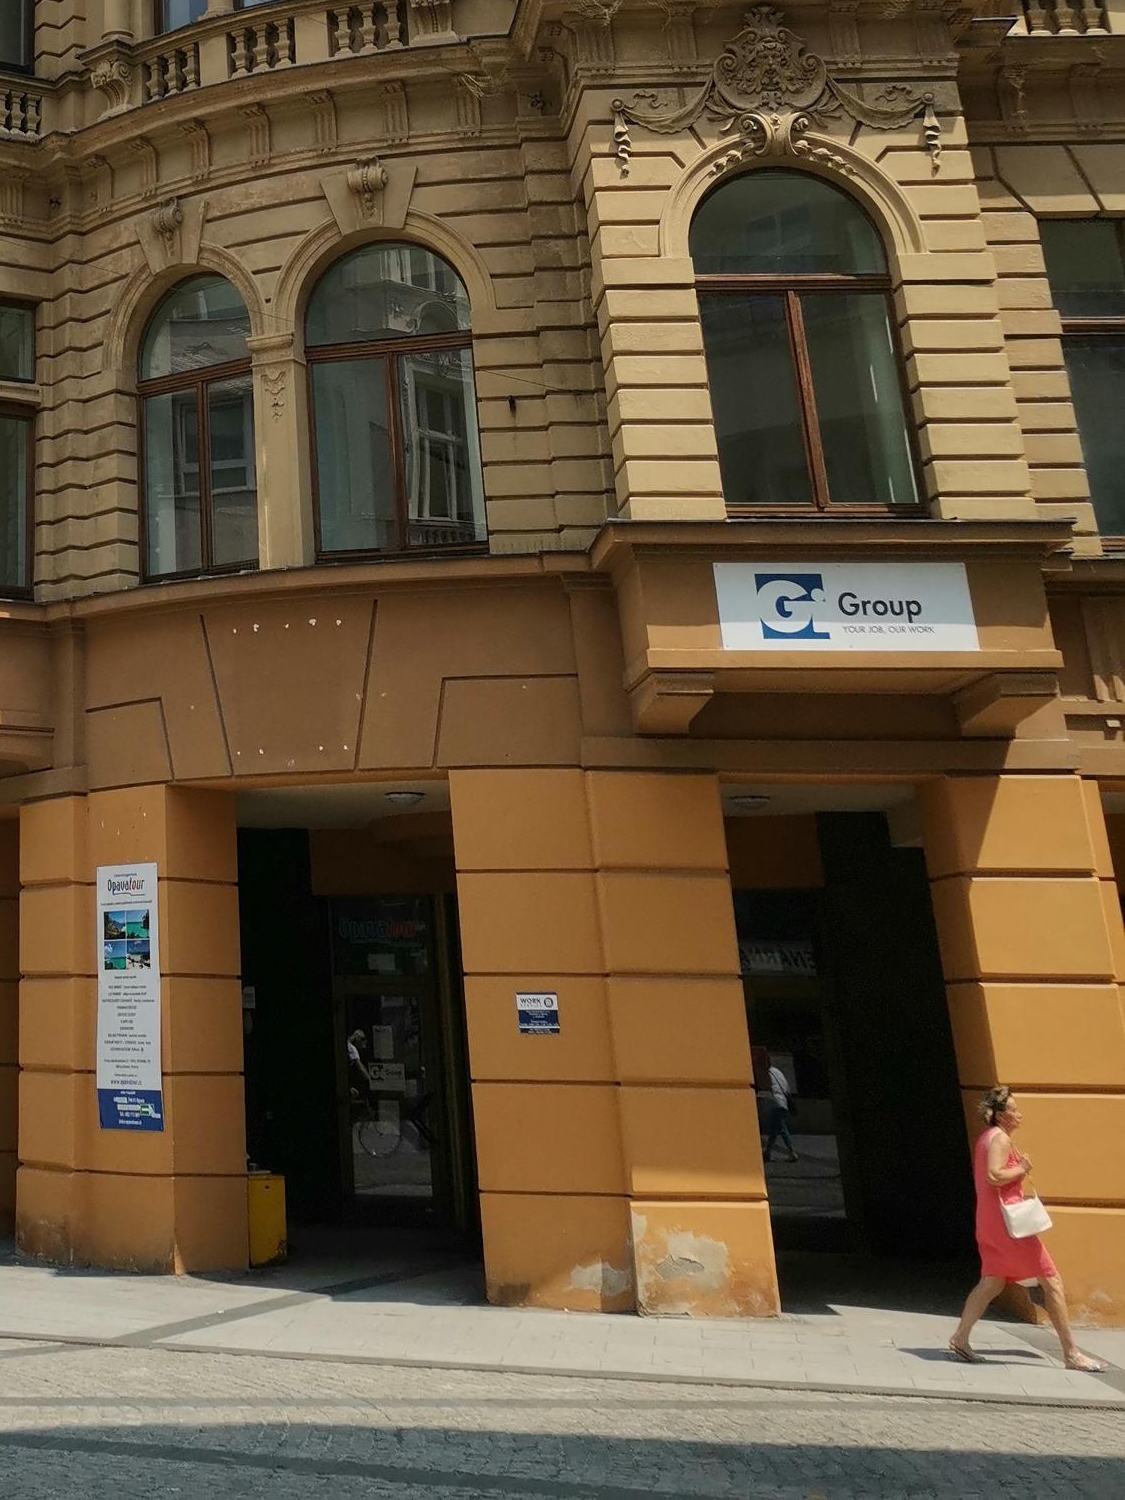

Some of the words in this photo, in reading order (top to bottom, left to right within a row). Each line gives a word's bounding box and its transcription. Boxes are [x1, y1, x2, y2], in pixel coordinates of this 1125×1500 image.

[838, 592, 922, 623] Group
[843, 626, 866, 634] YOUR
[869, 626, 887, 634] JOB,
[888, 626, 907, 634] OUR
[907, 626, 936, 634] WORK
[108, 878, 144, 895] Opavatour
